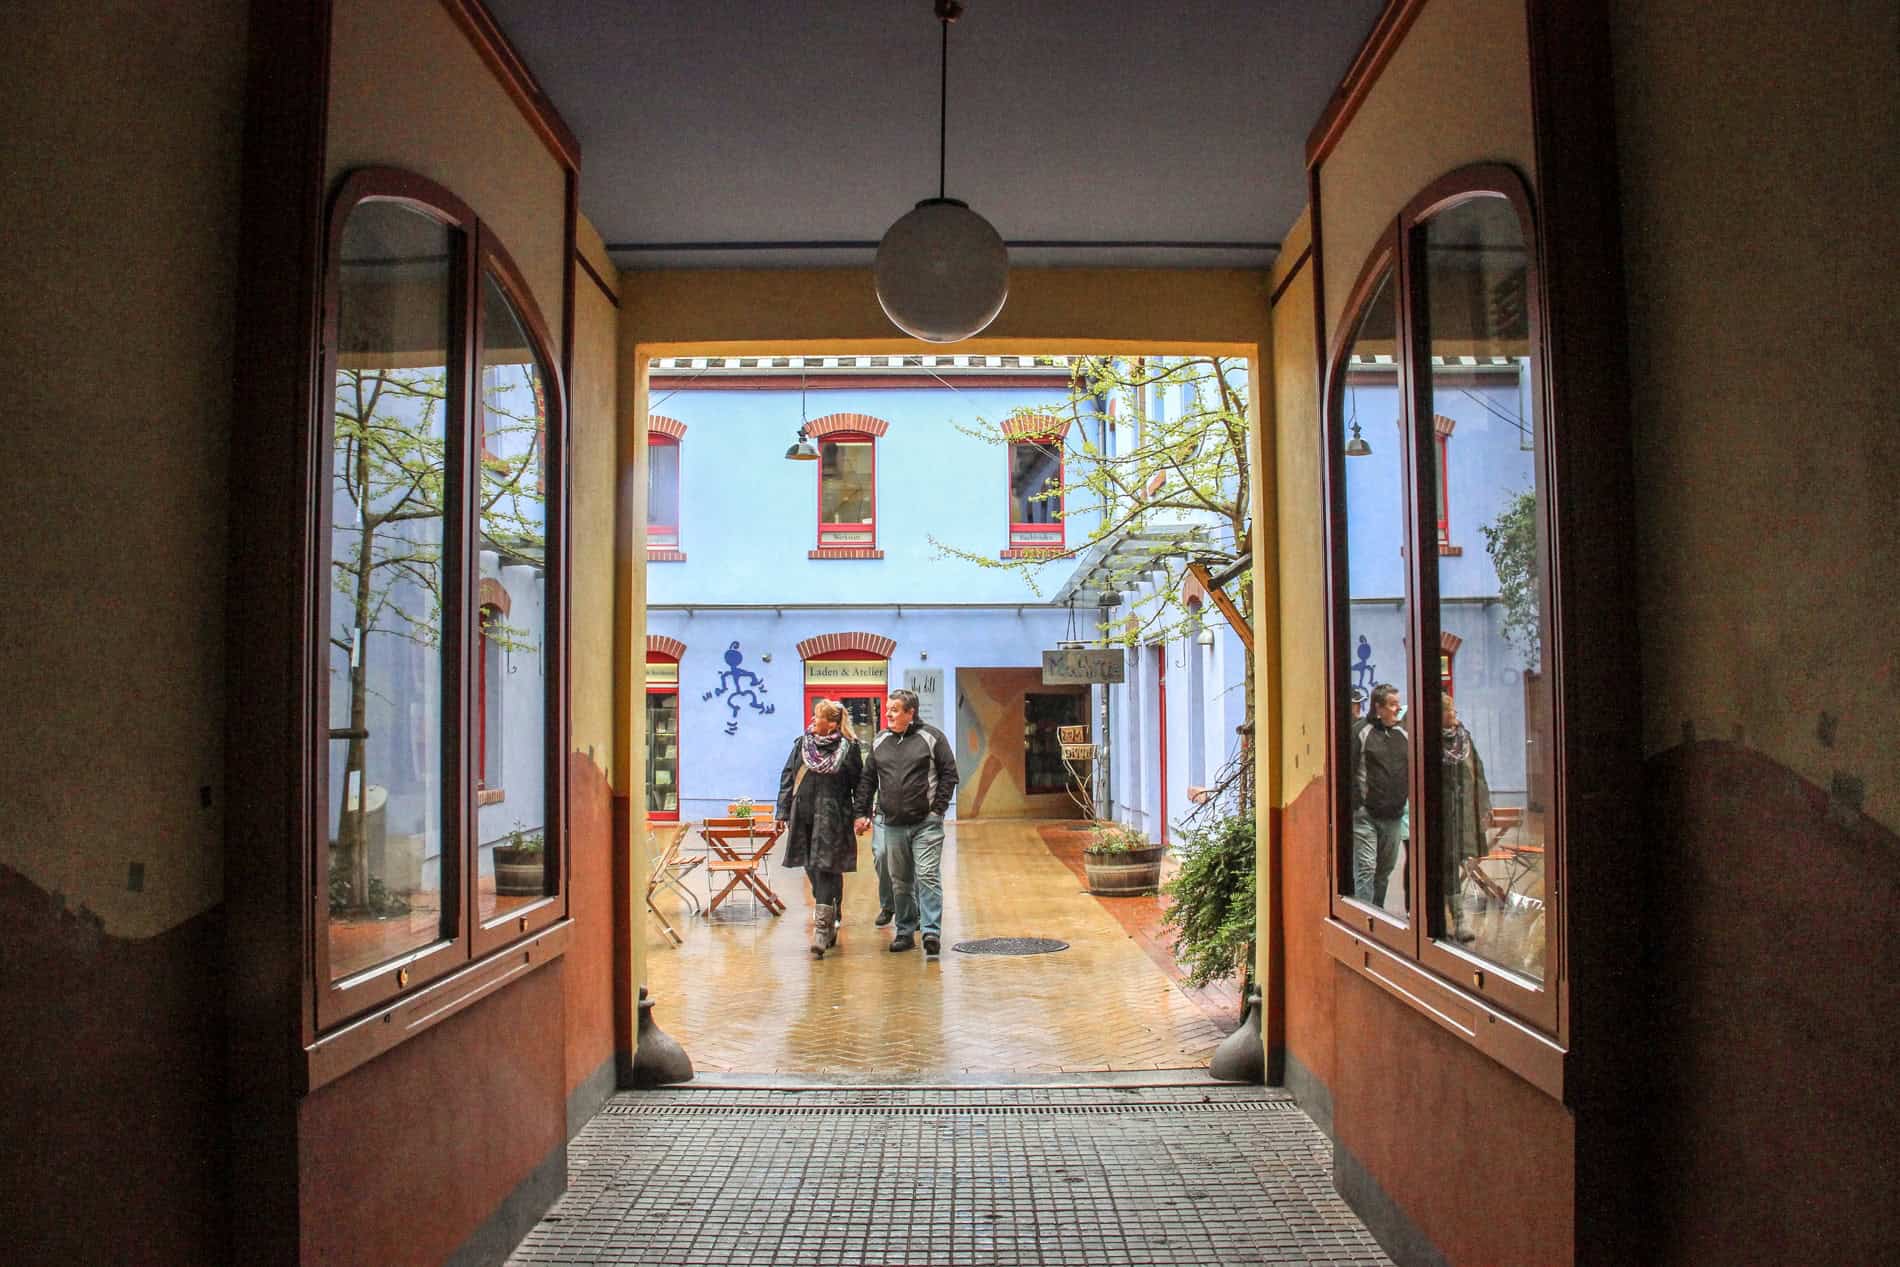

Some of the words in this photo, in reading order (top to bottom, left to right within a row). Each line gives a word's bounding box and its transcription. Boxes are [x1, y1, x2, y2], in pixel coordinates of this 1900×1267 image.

[810, 666, 838, 677] Laden
[841, 666, 849, 677] &
[853, 666, 884, 677] Atelier
